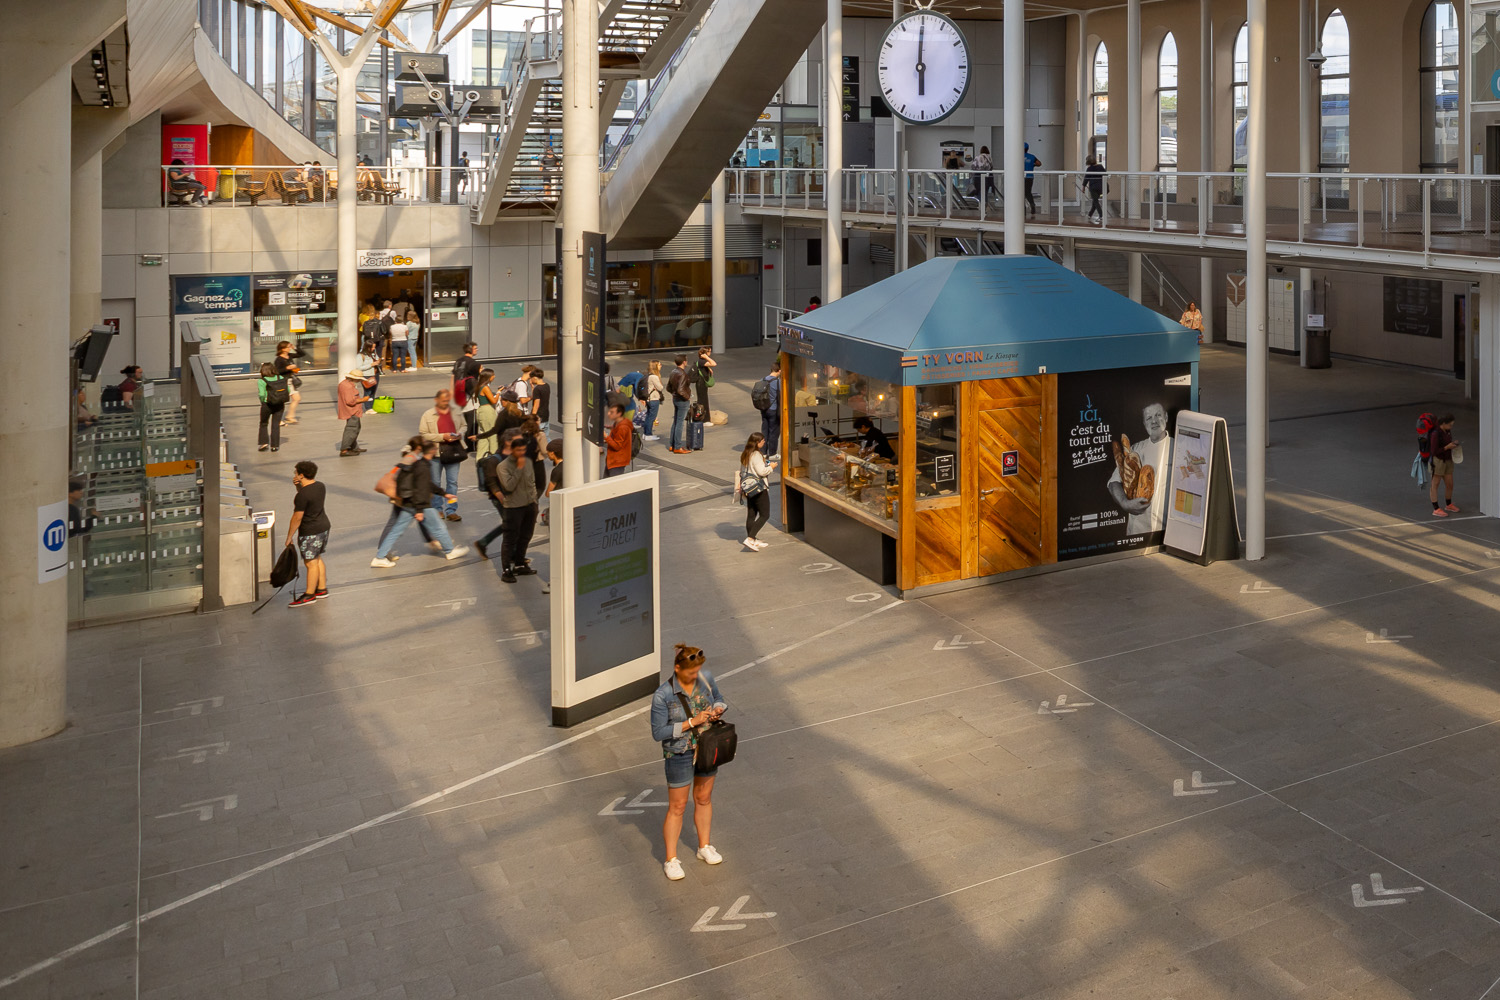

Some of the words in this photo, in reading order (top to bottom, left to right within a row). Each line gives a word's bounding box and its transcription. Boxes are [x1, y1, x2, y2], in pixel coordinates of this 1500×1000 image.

[184, 294, 224, 303] Gagnez
[205, 301, 237, 309] temps
[922, 354, 940, 366] TY
[945, 351, 984, 364] VORN
[995, 352, 1019, 361] Kiosque
[1080, 408, 1102, 422] ICI,
[1070, 425, 1093, 436] c'est
[1096, 423, 1110, 433] du
[1069, 437, 1091, 447] tout
[1092, 433, 1112, 444] cuit
[1085, 445, 1104, 456] pétri
[1073, 457, 1085, 466] sur
[1088, 452, 1108, 464] place
[605, 512, 637, 532] TRAIN
[1100, 517, 1126, 526] artisanal
[602, 527, 638, 549] DIRECT
